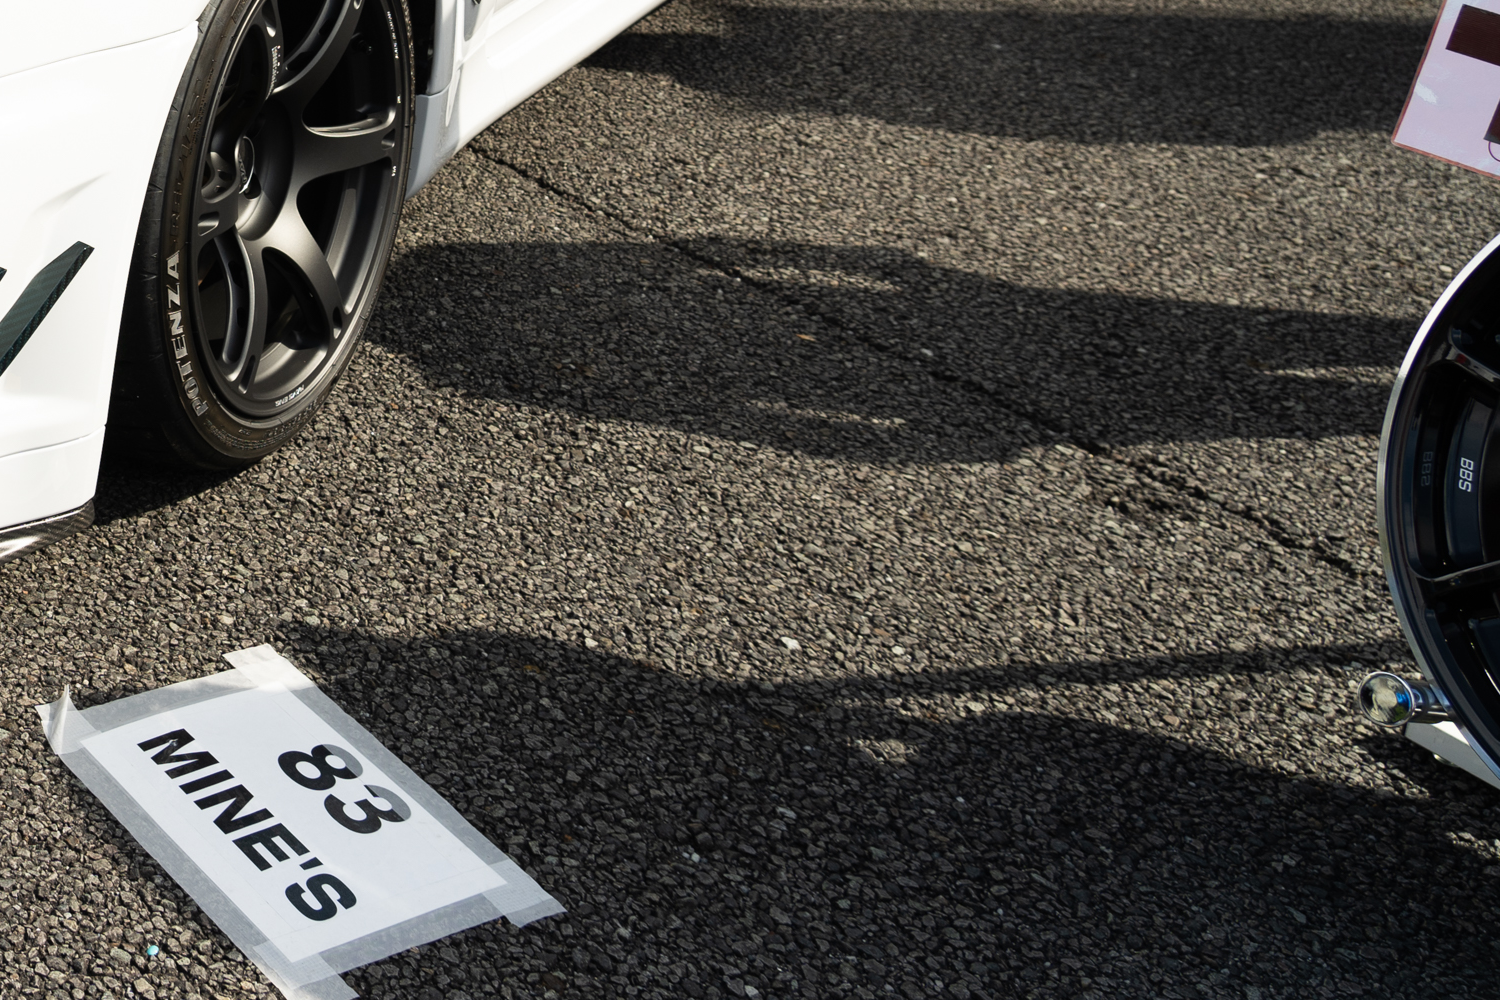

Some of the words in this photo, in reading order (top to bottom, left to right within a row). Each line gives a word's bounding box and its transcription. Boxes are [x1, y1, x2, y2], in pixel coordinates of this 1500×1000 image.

[166, 251, 209, 416] POTENZA
[1458, 456, 1474, 492] BBS
[137, 728, 358, 922] MINE'S
[277, 743, 412, 835] 83
